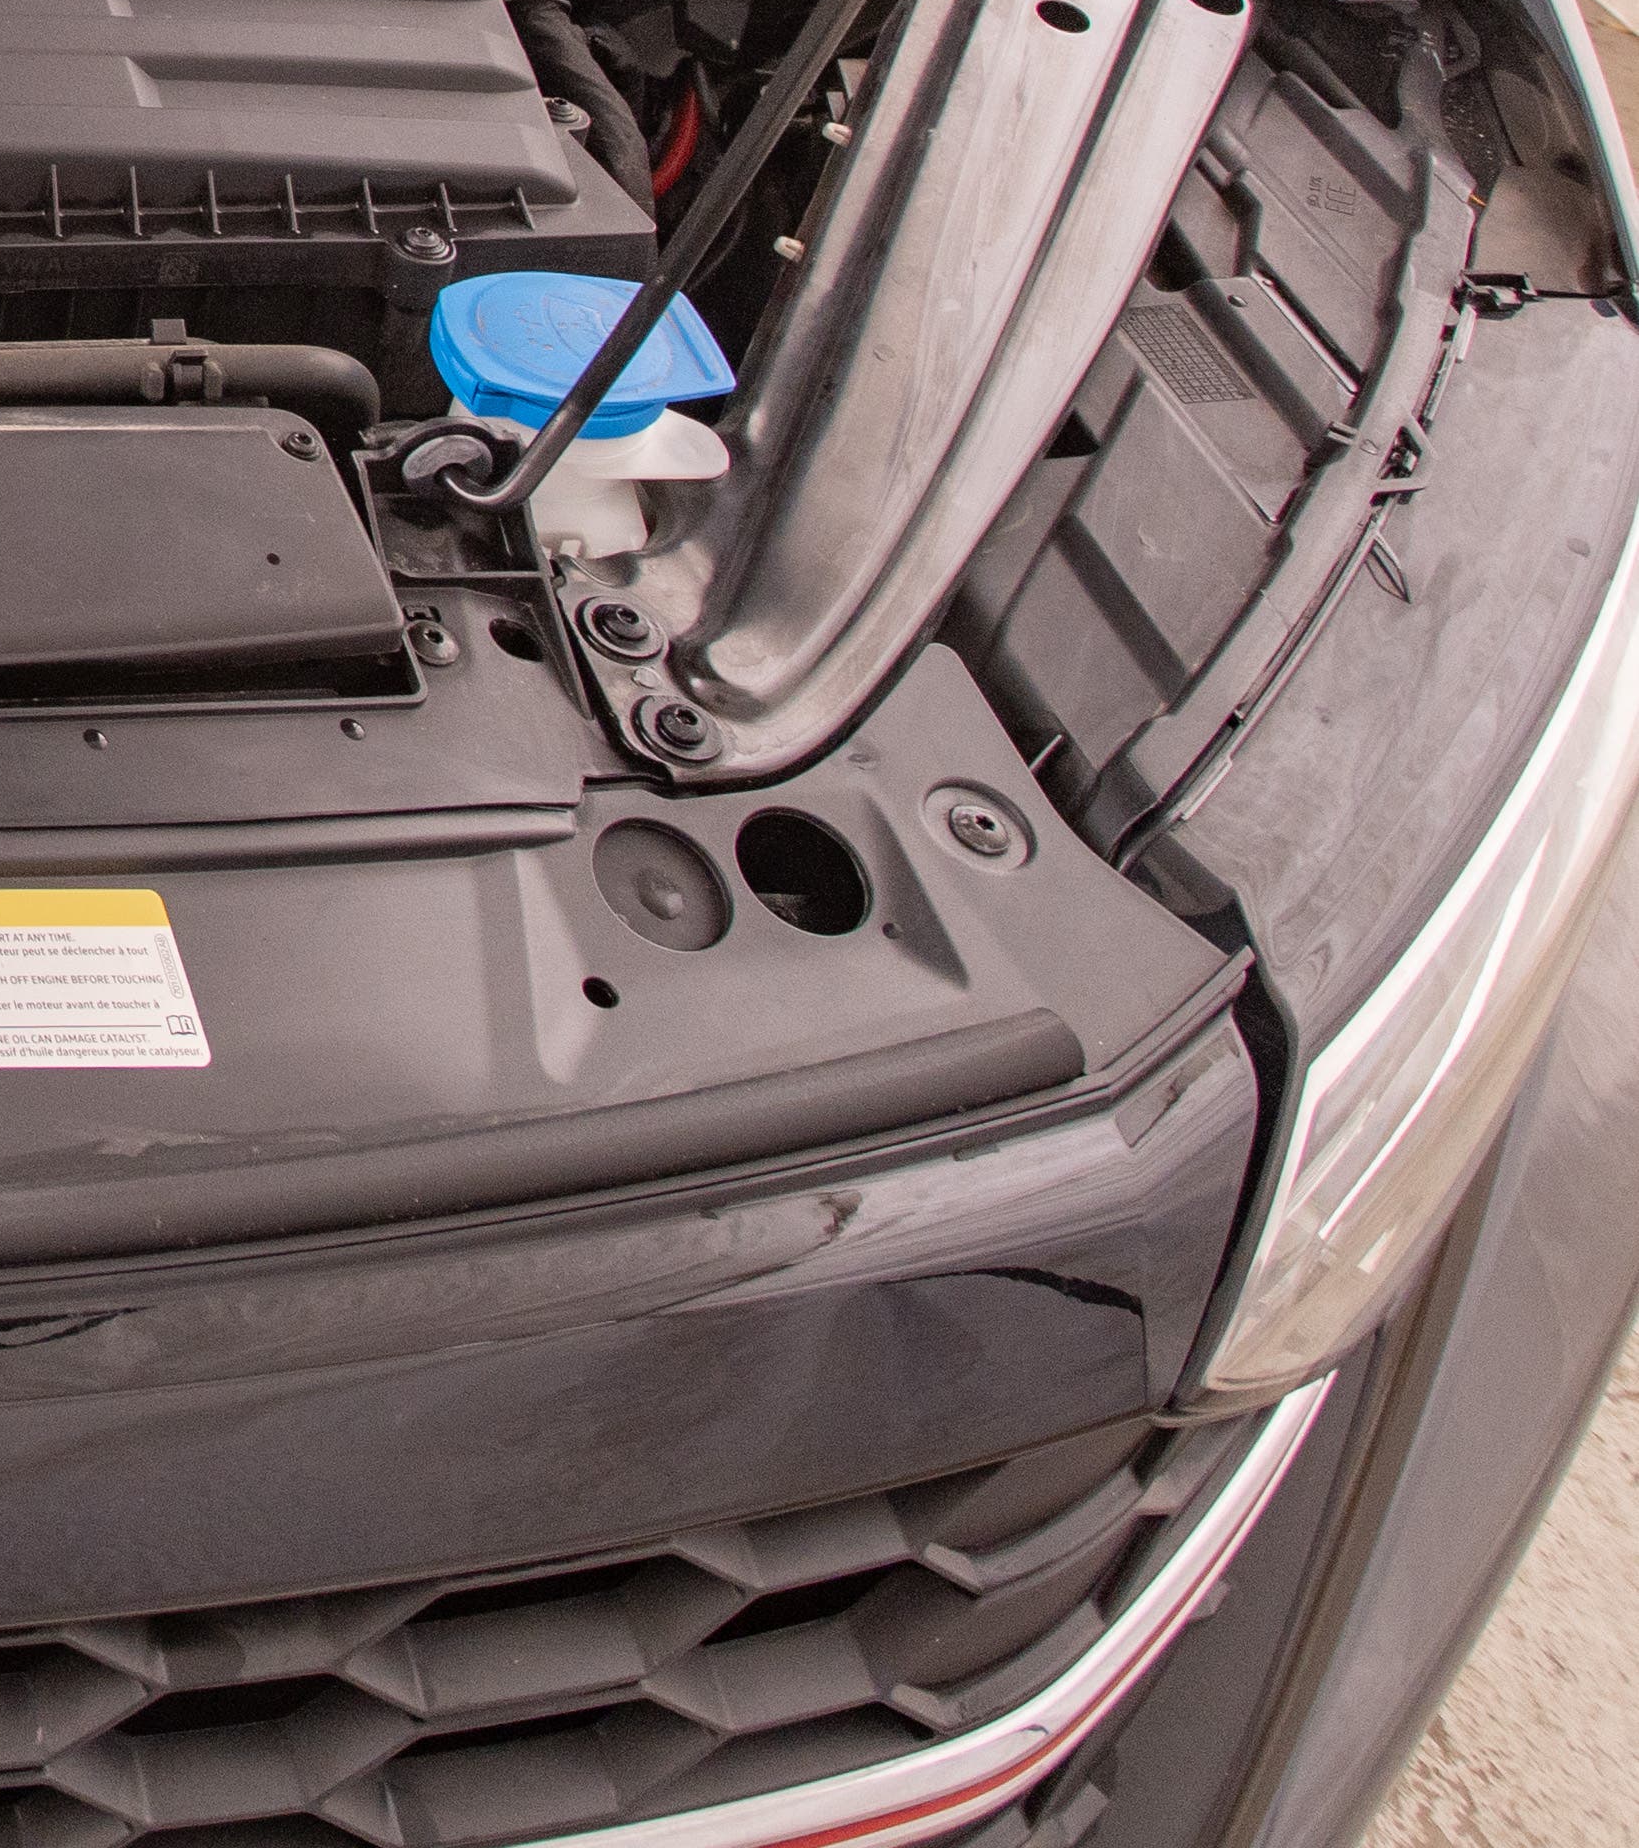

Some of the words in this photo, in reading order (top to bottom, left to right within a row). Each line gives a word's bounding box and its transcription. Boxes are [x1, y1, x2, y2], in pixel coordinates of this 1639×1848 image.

[13, 933, 24, 942] AT
[27, 933, 47, 942] ANY
[48, 933, 76, 942] TIME.
[23, 947, 45, 958] peut
[48, 948, 59, 956] se
[61, 946, 117, 956] déclencher
[119, 946, 125, 956] à
[126, 947, 148, 956] tout
[9, 975, 29, 985] OFF
[32, 975, 69, 985] ENGINE
[71, 975, 110, 984] BEFORE
[112, 974, 164, 984] TOUCHING
[14, 1000, 24, 1010] le
[26, 1001, 64, 1010] moteur
[66, 1000, 95, 1010] avant
[98, 1000, 110, 1009] de
[112, 1000, 152, 1009] toucher
[154, 999, 161, 1009] à
[13, 1035, 29, 1044] OIL
[31, 1034, 53, 1043] CAN
[55, 1034, 98, 1043] DAMAGE
[103, 1033, 151, 1043] CATALYST.
[21, 1047, 54, 1057] d'huile
[56, 1047, 110, 1060] dangereux
[112, 1048, 135, 1059] pour
[137, 1047, 146, 1057] le
[148, 1046, 204, 1059] catalyseur.
